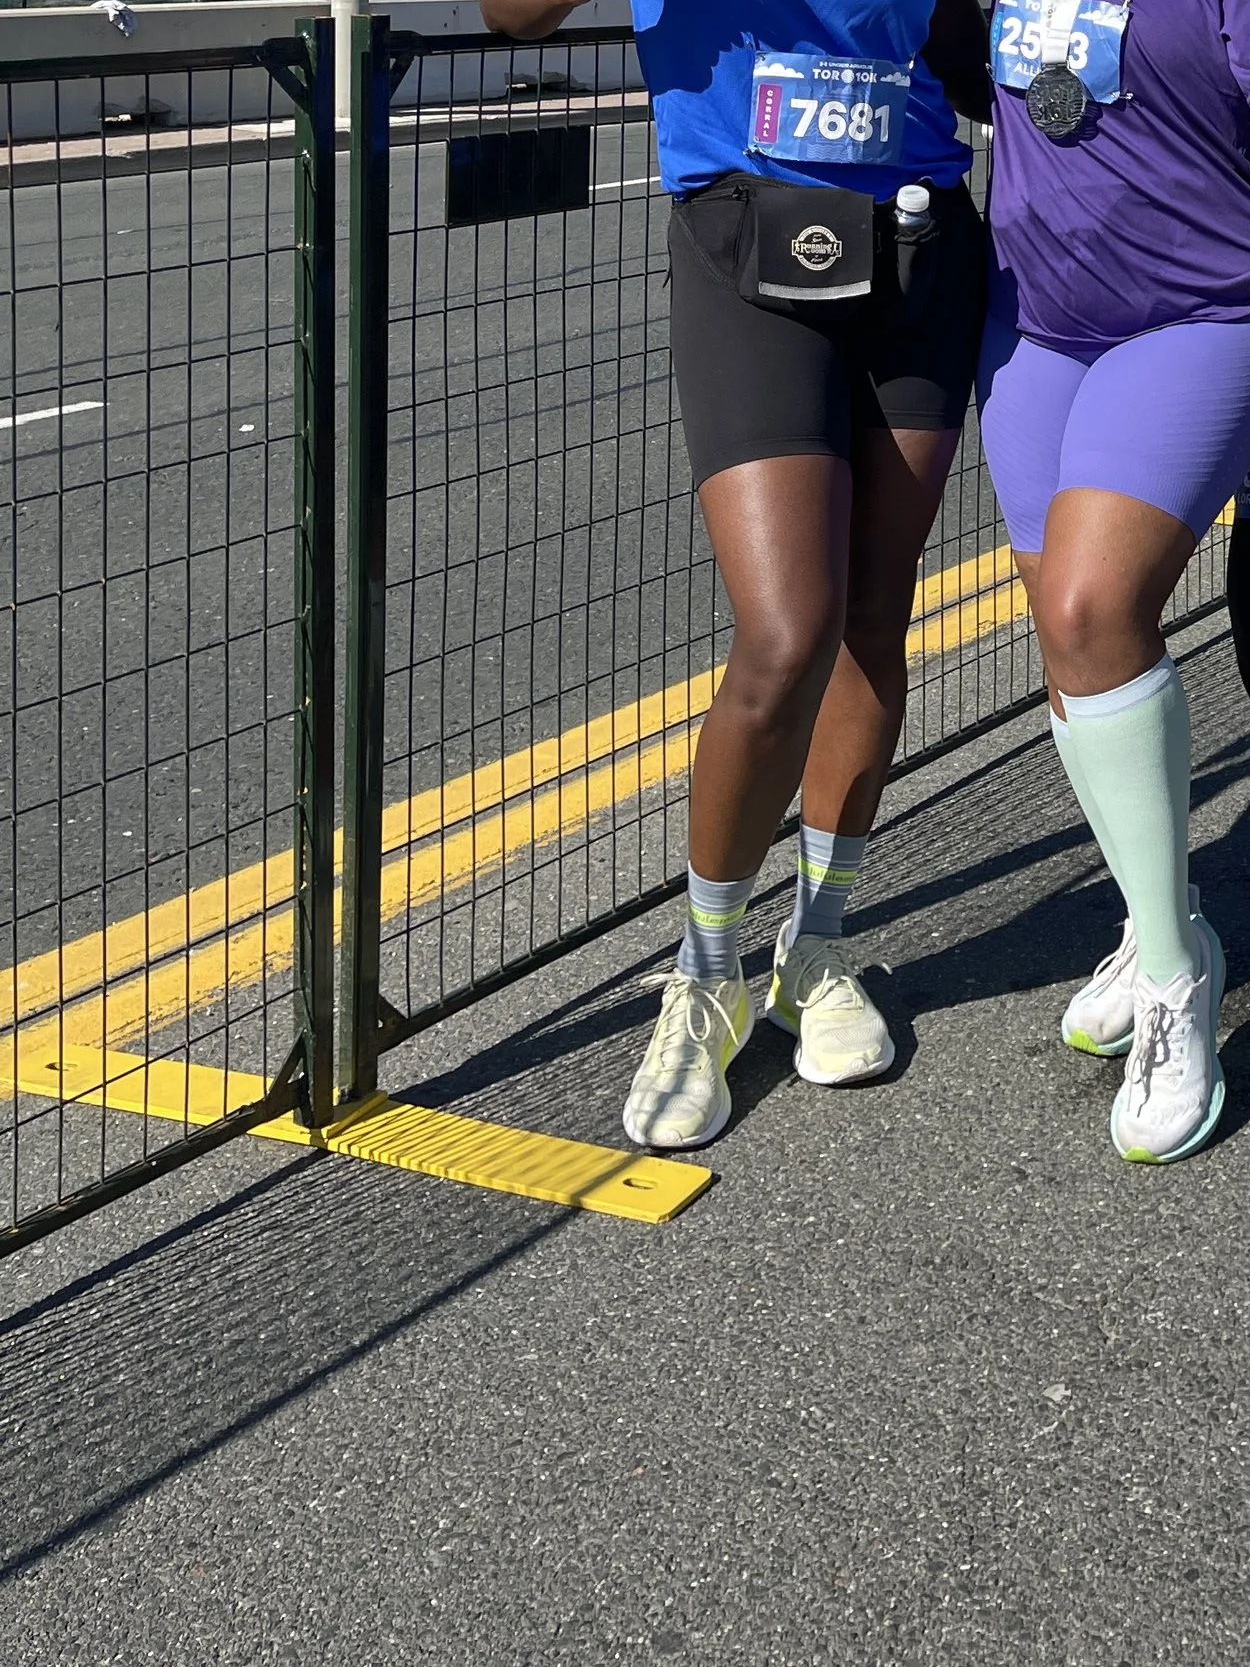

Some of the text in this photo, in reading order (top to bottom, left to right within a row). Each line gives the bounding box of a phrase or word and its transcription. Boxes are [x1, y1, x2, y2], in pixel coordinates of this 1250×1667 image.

[812, 68, 878, 83] TOR 10K
[762, 89, 774, 137] CORRAL
[790, 98, 890, 143] 7681
